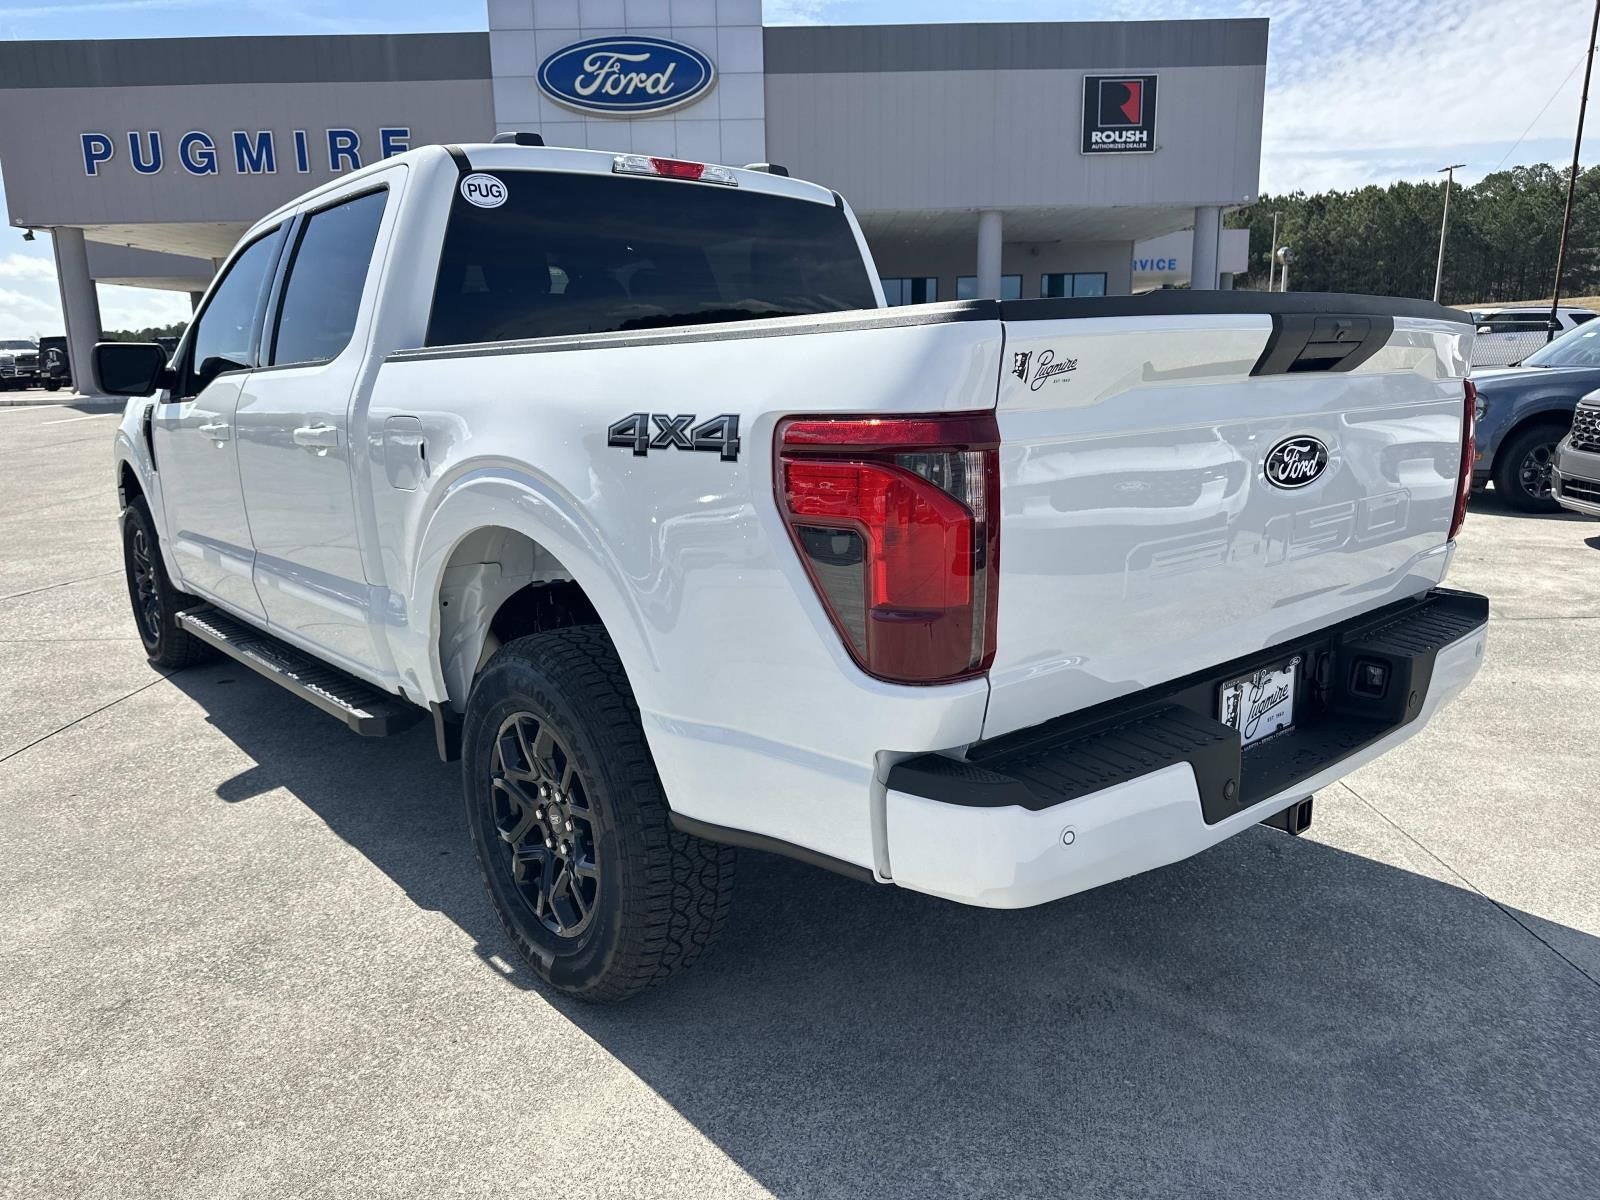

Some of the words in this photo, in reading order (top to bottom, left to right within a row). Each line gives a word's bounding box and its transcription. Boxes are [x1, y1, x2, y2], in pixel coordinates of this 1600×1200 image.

[574, 52, 677, 96] Ford
[80, 127, 411, 176] PUGMIRE
[1091, 130, 1147, 143] ROUSH
[467, 183, 503, 198] PUG
[1030, 349, 1079, 391] Pugmire
[1278, 445, 1320, 480] Ford
[1244, 678, 1289, 740] Pugmire
